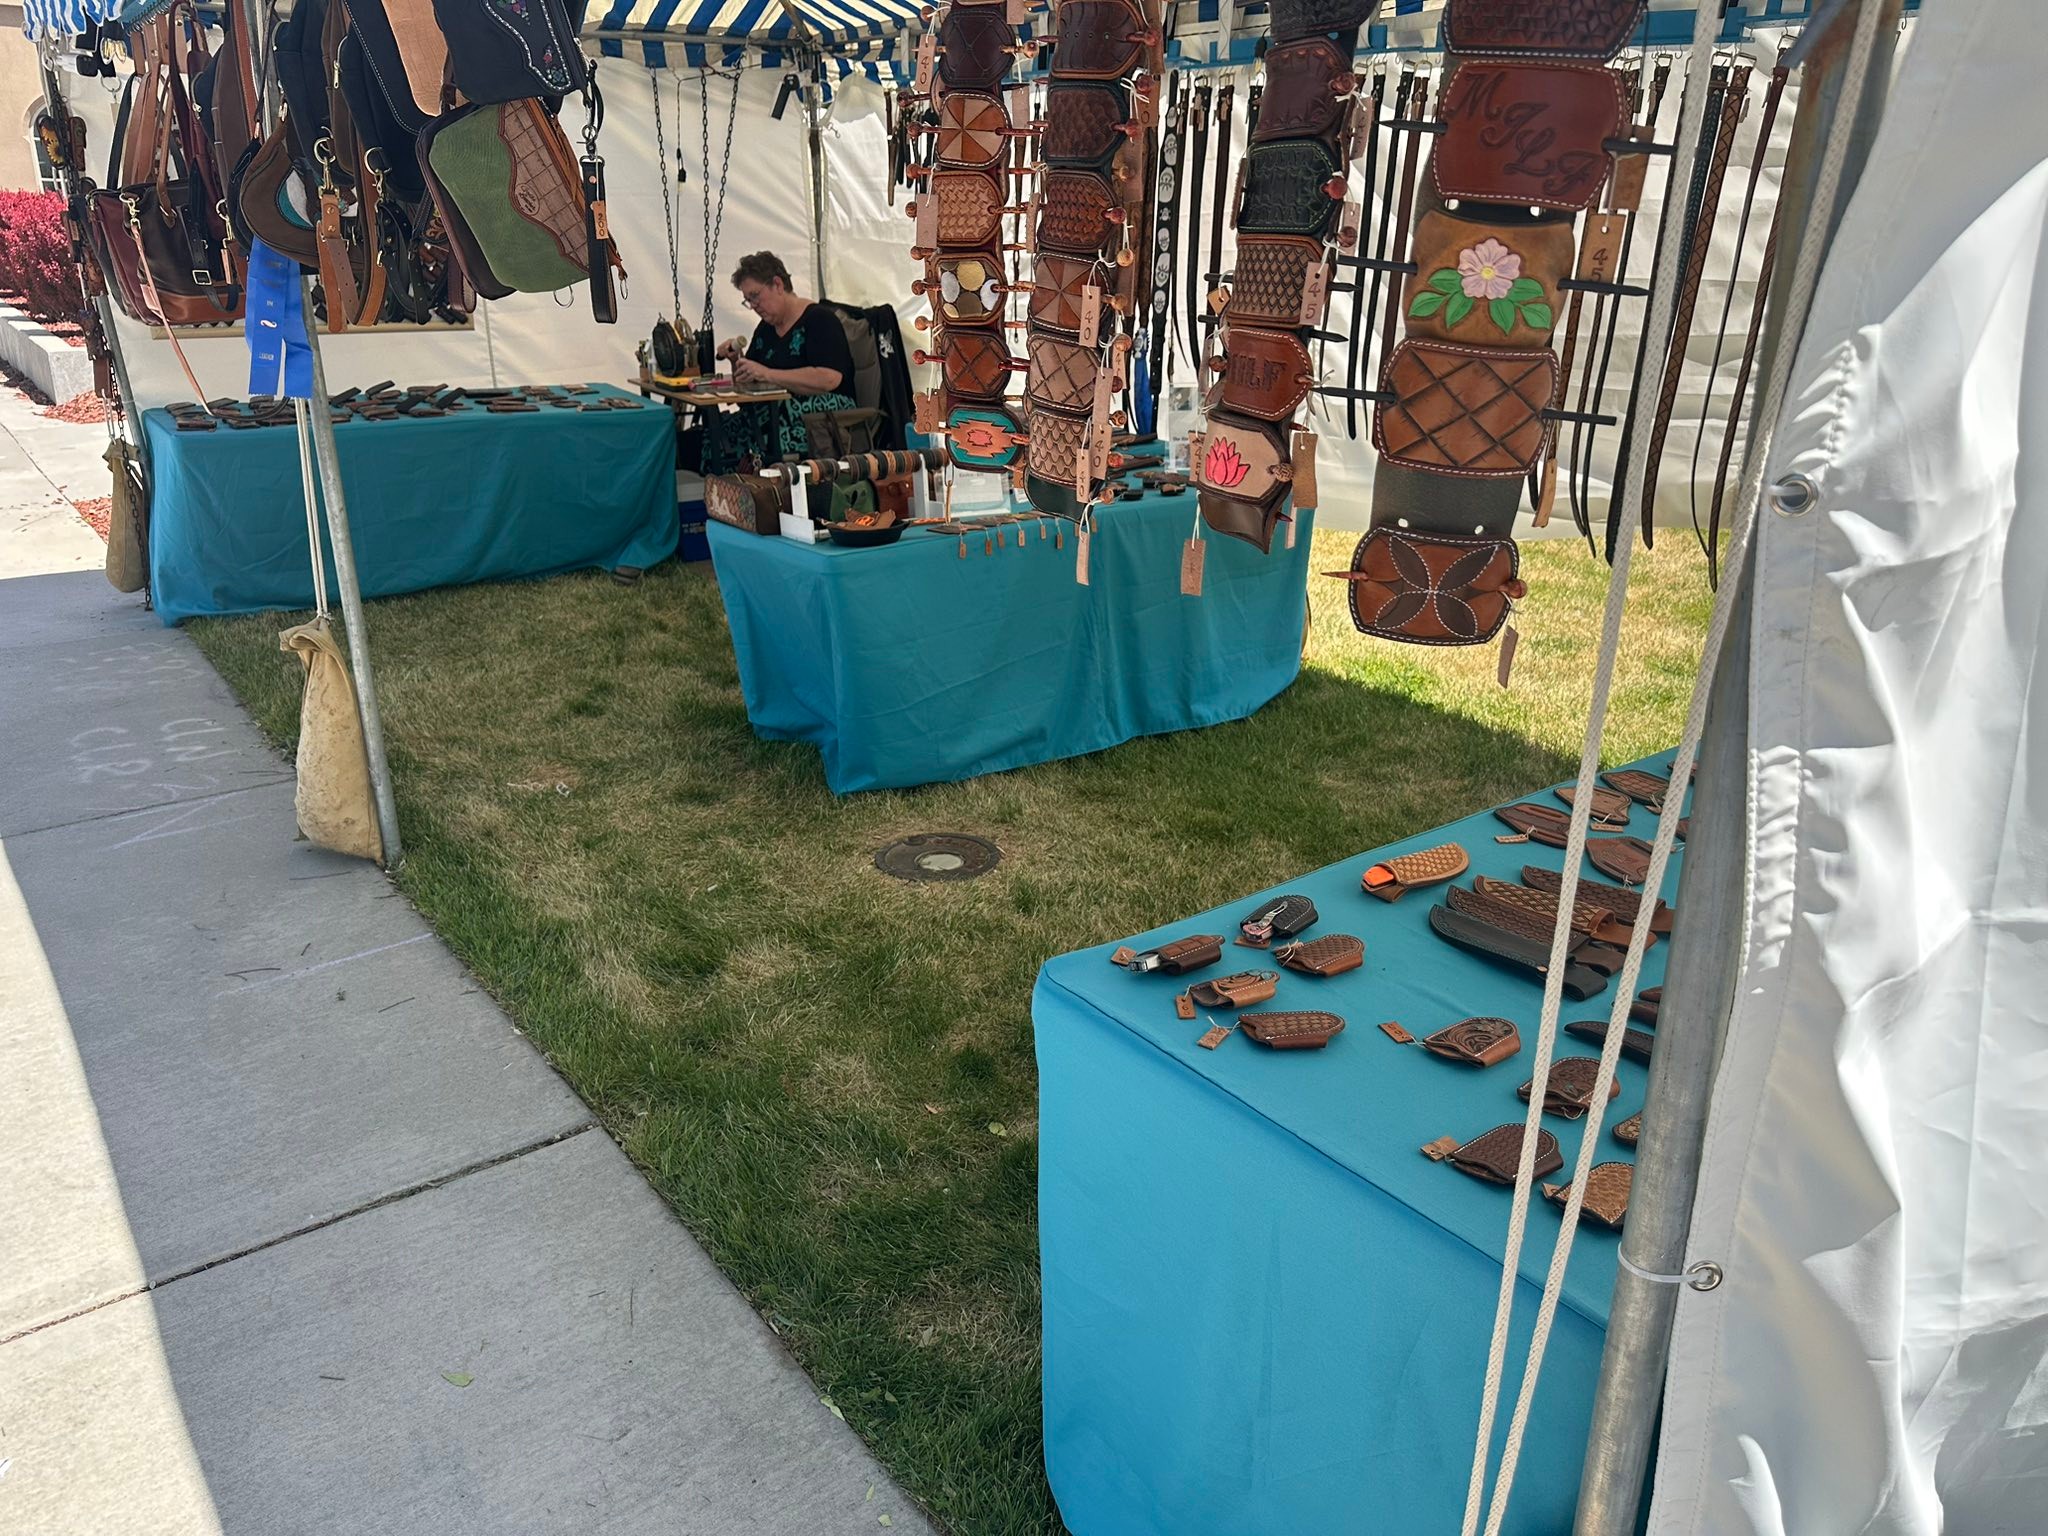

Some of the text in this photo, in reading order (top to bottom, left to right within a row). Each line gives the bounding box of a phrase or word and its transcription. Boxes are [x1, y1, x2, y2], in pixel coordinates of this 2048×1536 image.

[920, 56, 930, 84] 40
[597, 213, 605, 237] 200
[1305, 282, 1320, 320] 45
[1083, 311, 1093, 340] 40
[1093, 440, 1104, 467] 40
